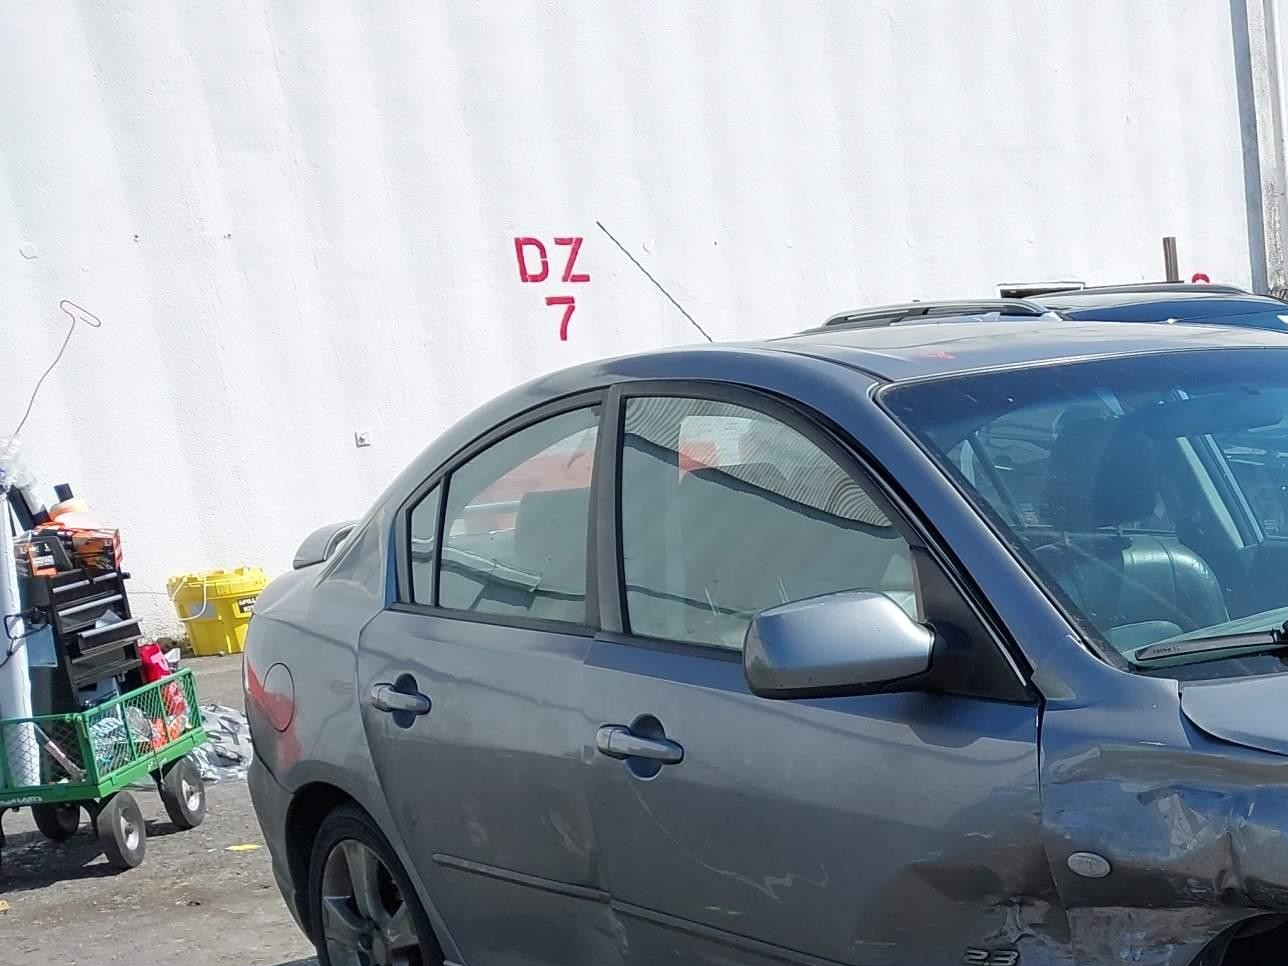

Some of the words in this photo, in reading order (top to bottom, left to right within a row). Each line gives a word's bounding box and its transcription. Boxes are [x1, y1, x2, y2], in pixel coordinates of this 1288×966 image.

[514, 237, 590, 282] DZ
[545, 296, 575, 341] 7
[961, 950, 1019, 966] 2.3
